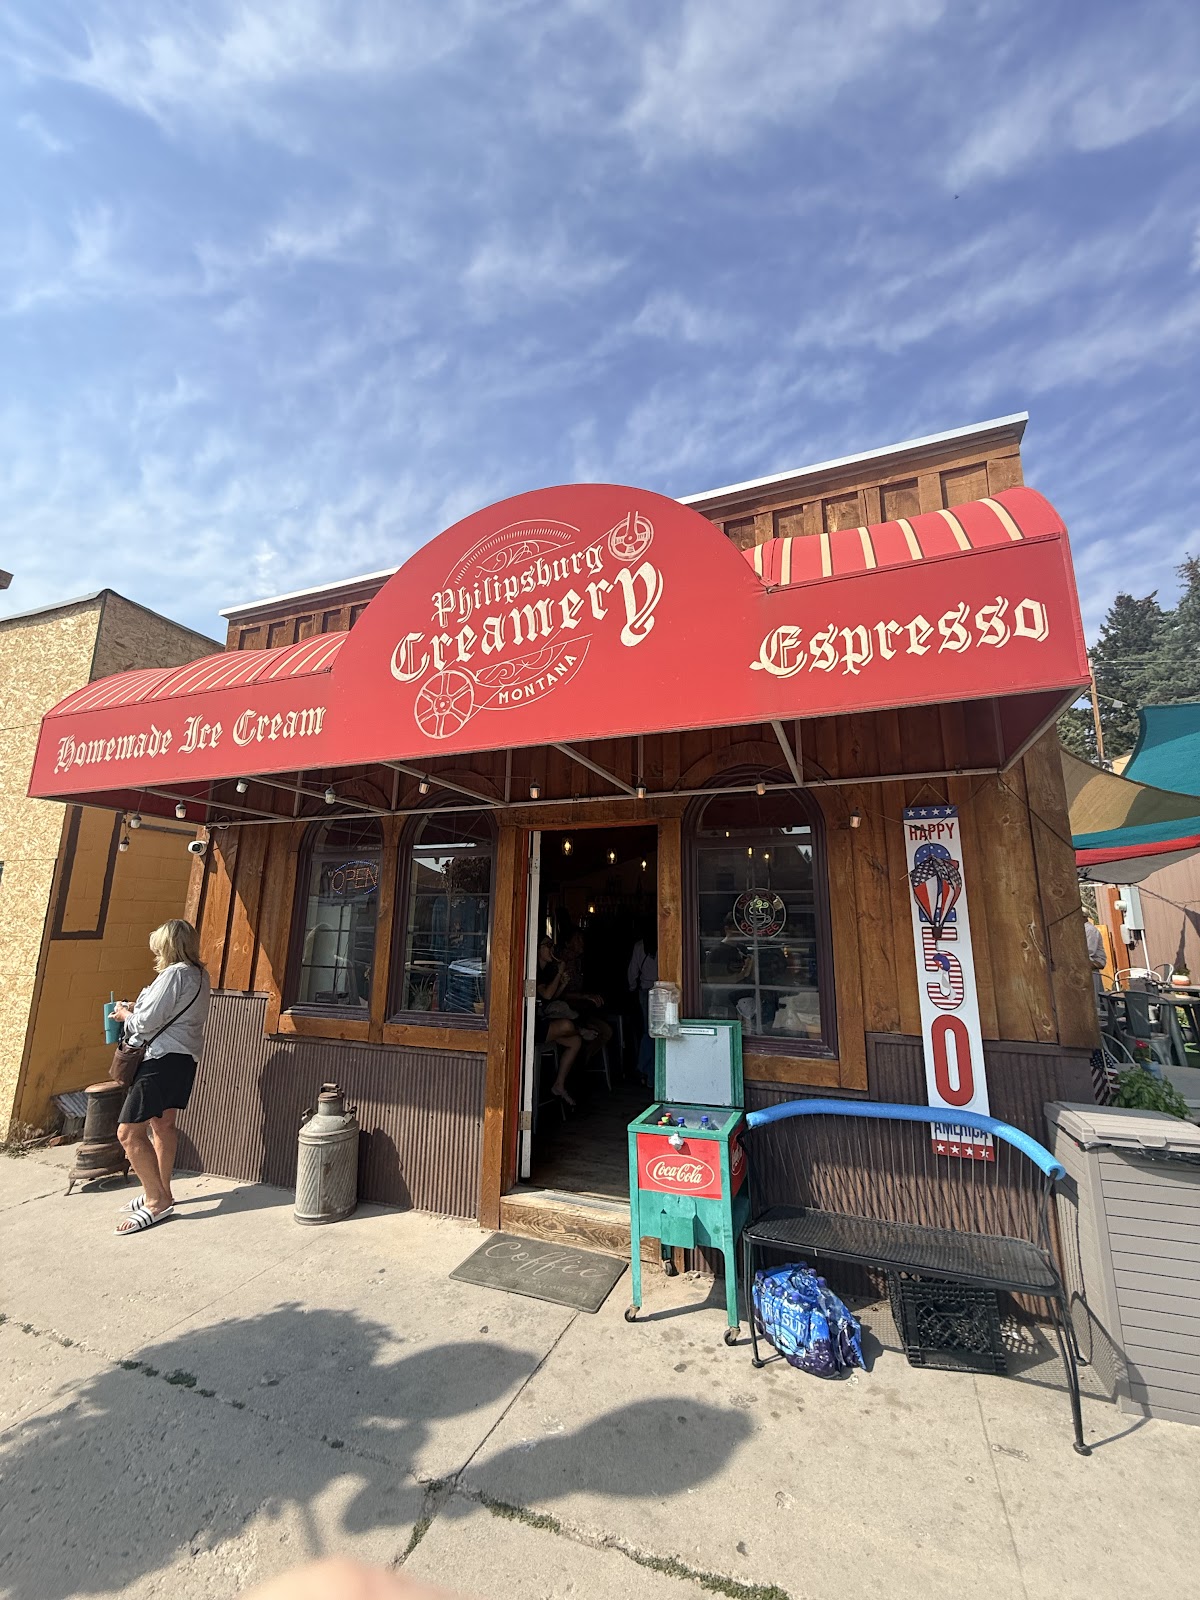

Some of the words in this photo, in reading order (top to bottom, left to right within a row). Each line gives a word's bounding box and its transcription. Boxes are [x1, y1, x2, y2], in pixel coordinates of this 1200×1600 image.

[431, 544, 604, 629] Philipsburg
[390, 561, 664, 685] Creamery
[749, 595, 1050, 679] Espresso
[498, 654, 578, 705] MONTANA
[53, 724, 173, 775] Homemade
[177, 713, 224, 754] Ice
[232, 706, 327, 747] Cream
[908, 822, 955, 842] HAPPY
[331, 866, 379, 891] OPEN
[652, 1161, 705, 1185] Coca-Cola
[484, 1241, 609, 1279] Coffee
